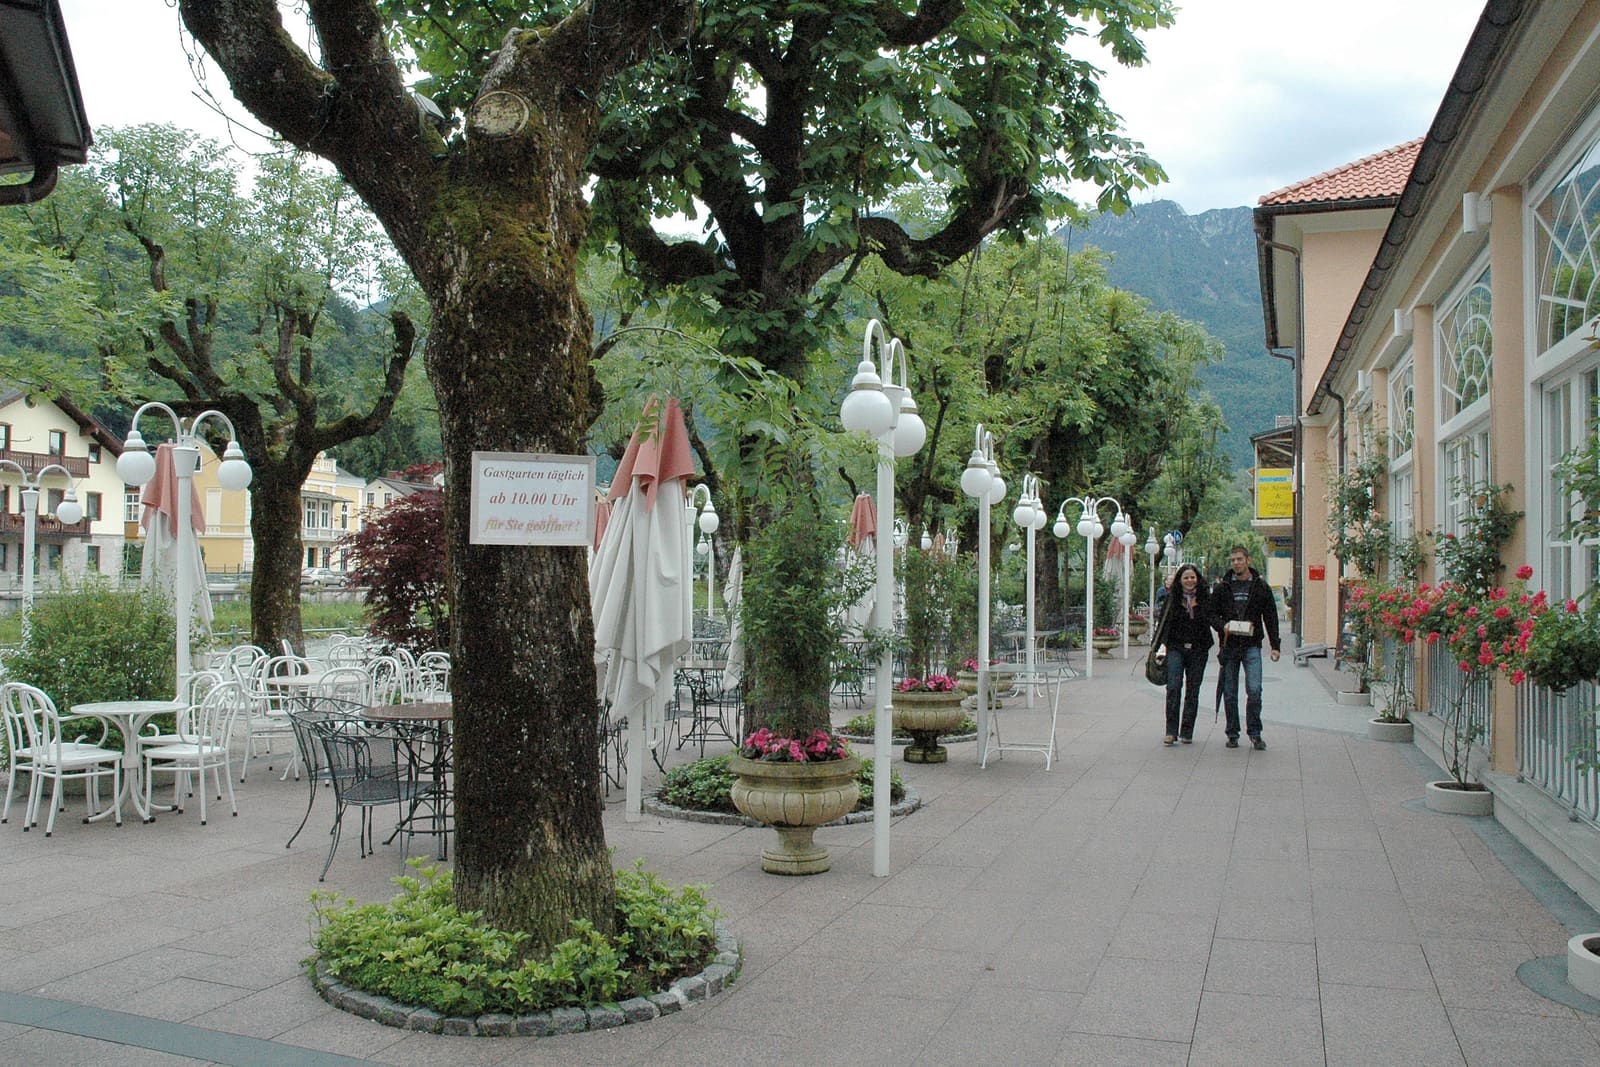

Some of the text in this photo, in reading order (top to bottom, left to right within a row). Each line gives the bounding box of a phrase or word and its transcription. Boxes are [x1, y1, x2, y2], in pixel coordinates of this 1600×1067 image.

[483, 466, 585, 482] Gastgarten täglich
[489, 491, 578, 506] ab 10.00 Uhr
[484, 517, 503, 532] für
[506, 516, 524, 530] Sie
[527, 514, 573, 533] geöffnet
